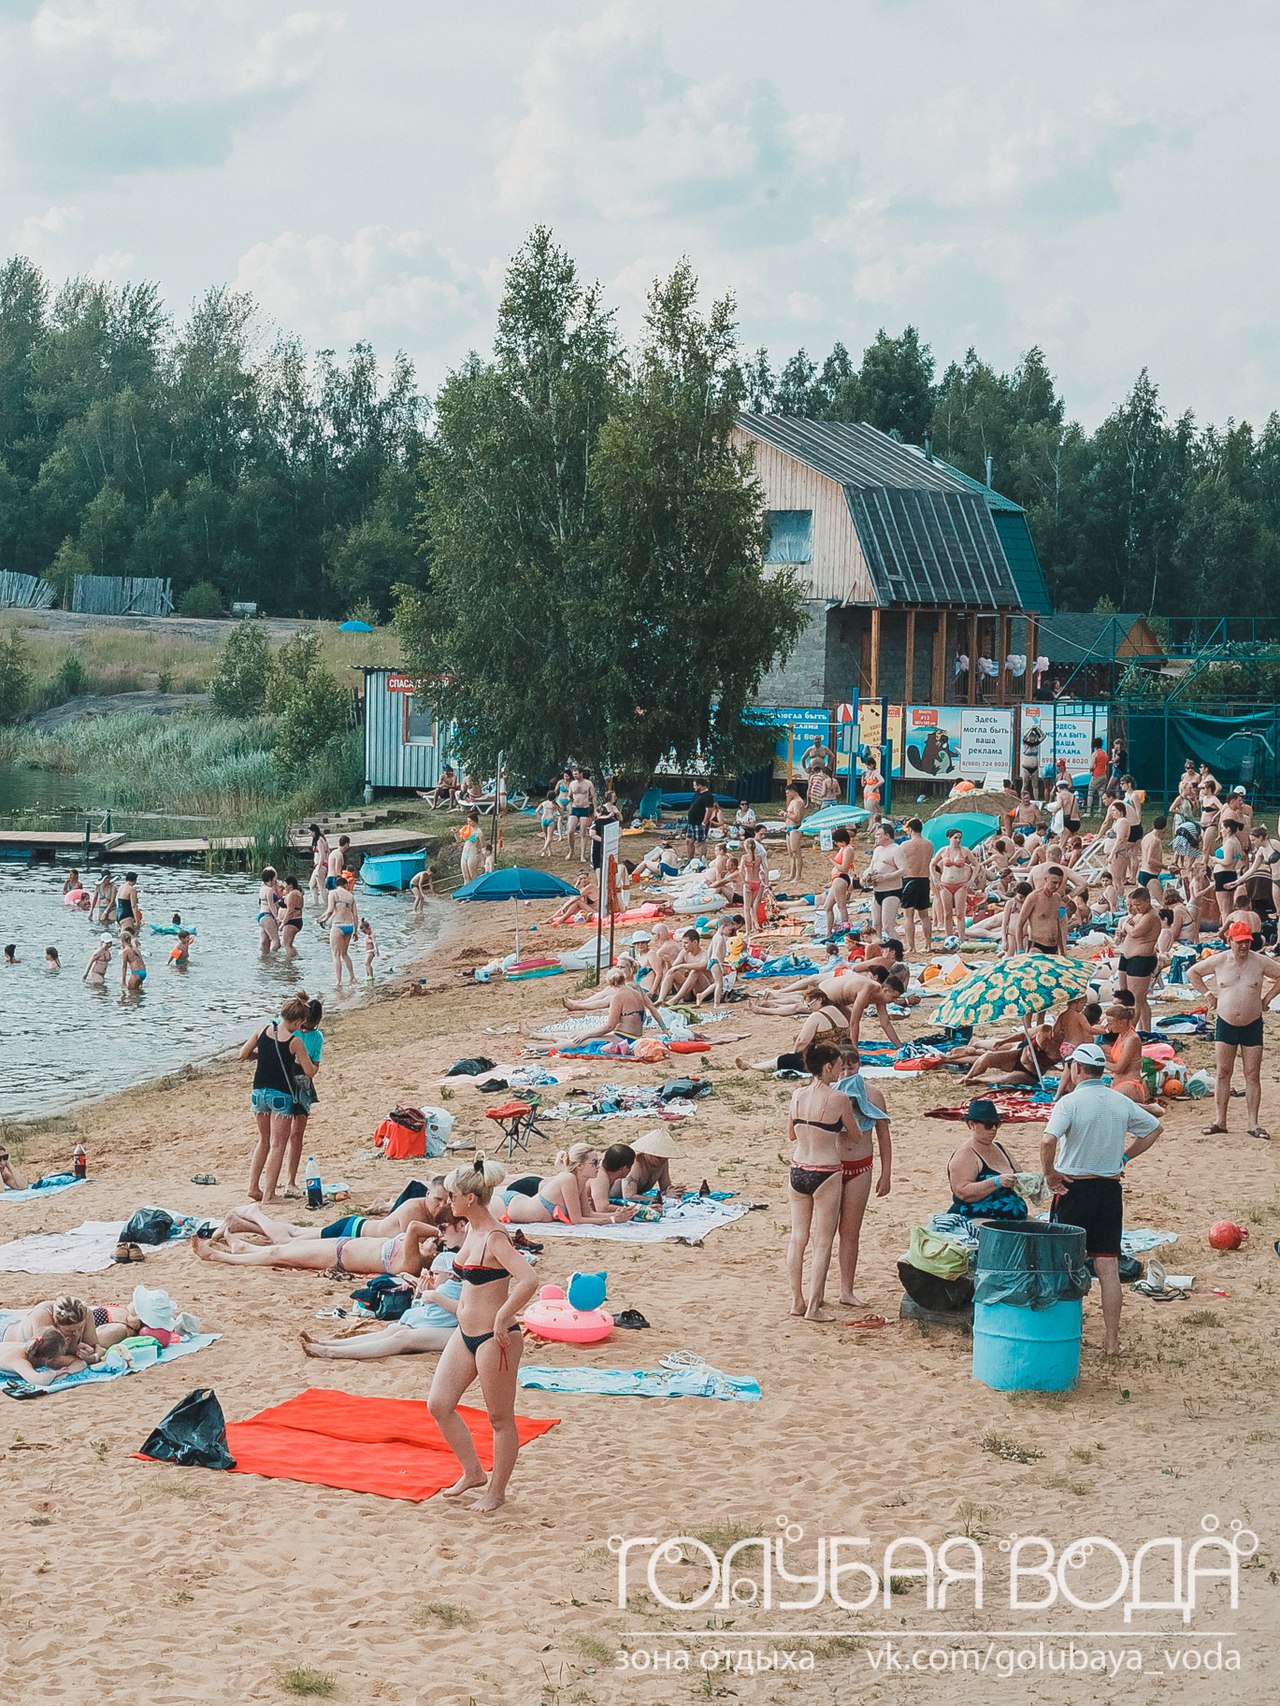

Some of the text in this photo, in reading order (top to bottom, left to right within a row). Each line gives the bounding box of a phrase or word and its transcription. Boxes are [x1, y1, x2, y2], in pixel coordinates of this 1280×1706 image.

[804, 711, 827, 720] быть
[975, 715, 998, 724] Здесь
[963, 726, 1009, 735] могла быть
[968, 748, 1003, 756] реклама
